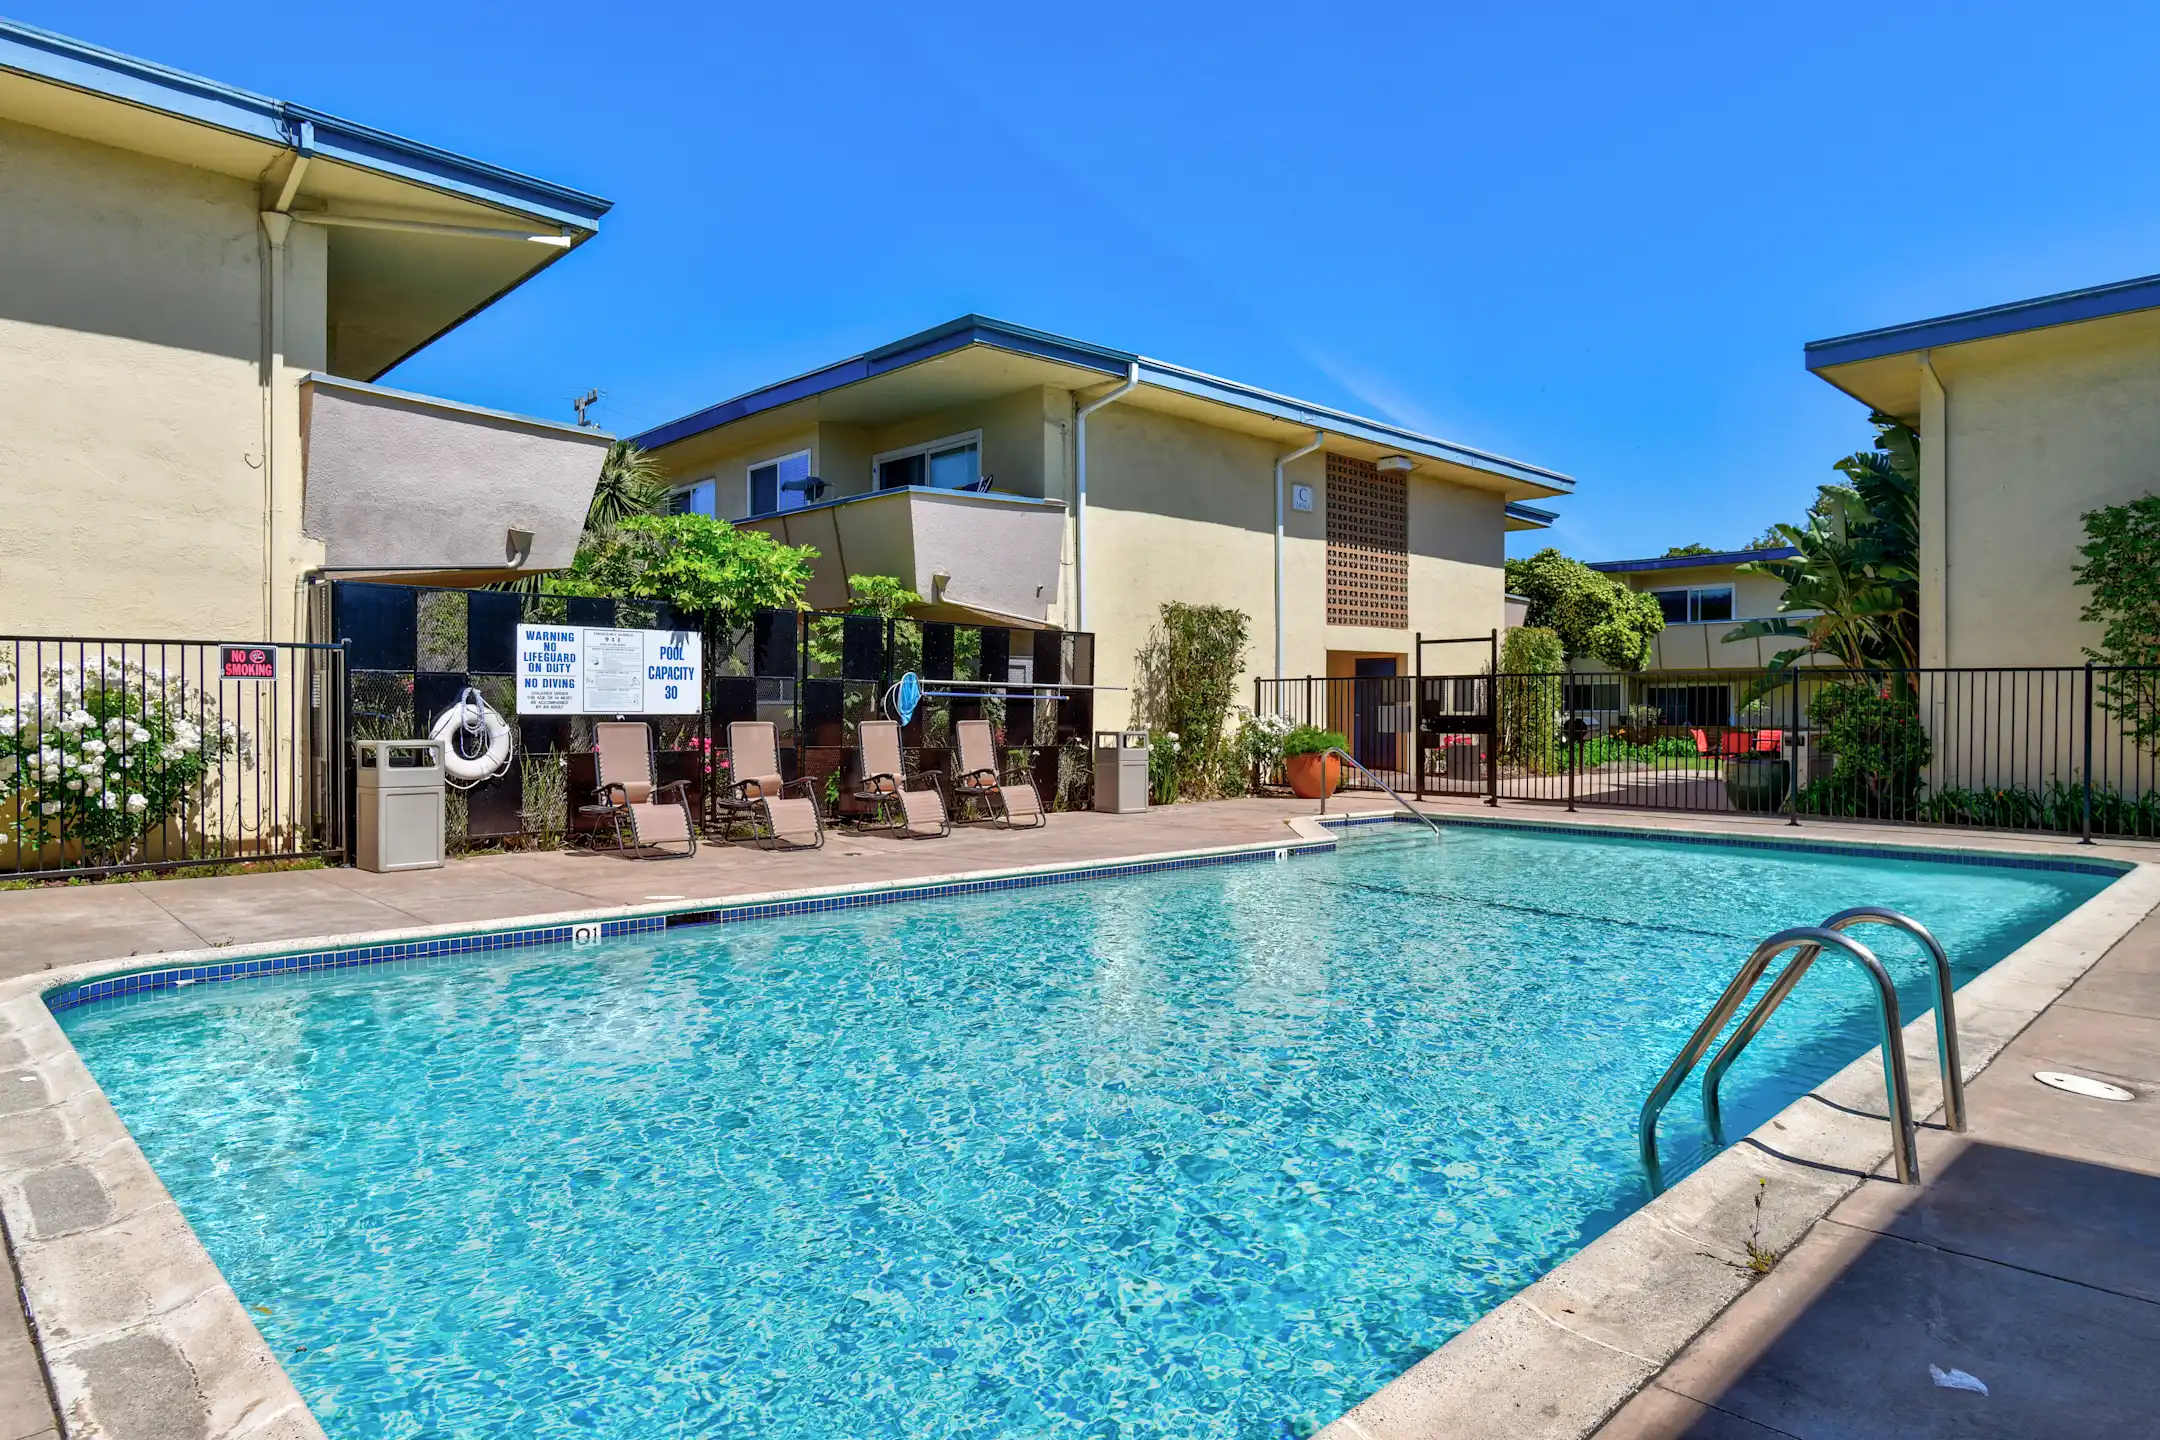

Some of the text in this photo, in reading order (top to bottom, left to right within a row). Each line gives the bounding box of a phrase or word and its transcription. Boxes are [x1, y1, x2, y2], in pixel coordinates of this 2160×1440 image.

[1299, 487, 1308, 502] C
[526, 631, 575, 642] WARNING
[544, 642, 557, 652] NO
[660, 646, 685, 660] POOL
[231, 650, 246, 663] NO
[523, 652, 576, 663] LIFEGUARD
[225, 663, 273, 676] SMOKING
[528, 662, 571, 673] ON DUTY
[648, 665, 695, 681] CAPACITY
[524, 678, 575, 689] NO DIVING
[664, 685, 678, 700] 30
